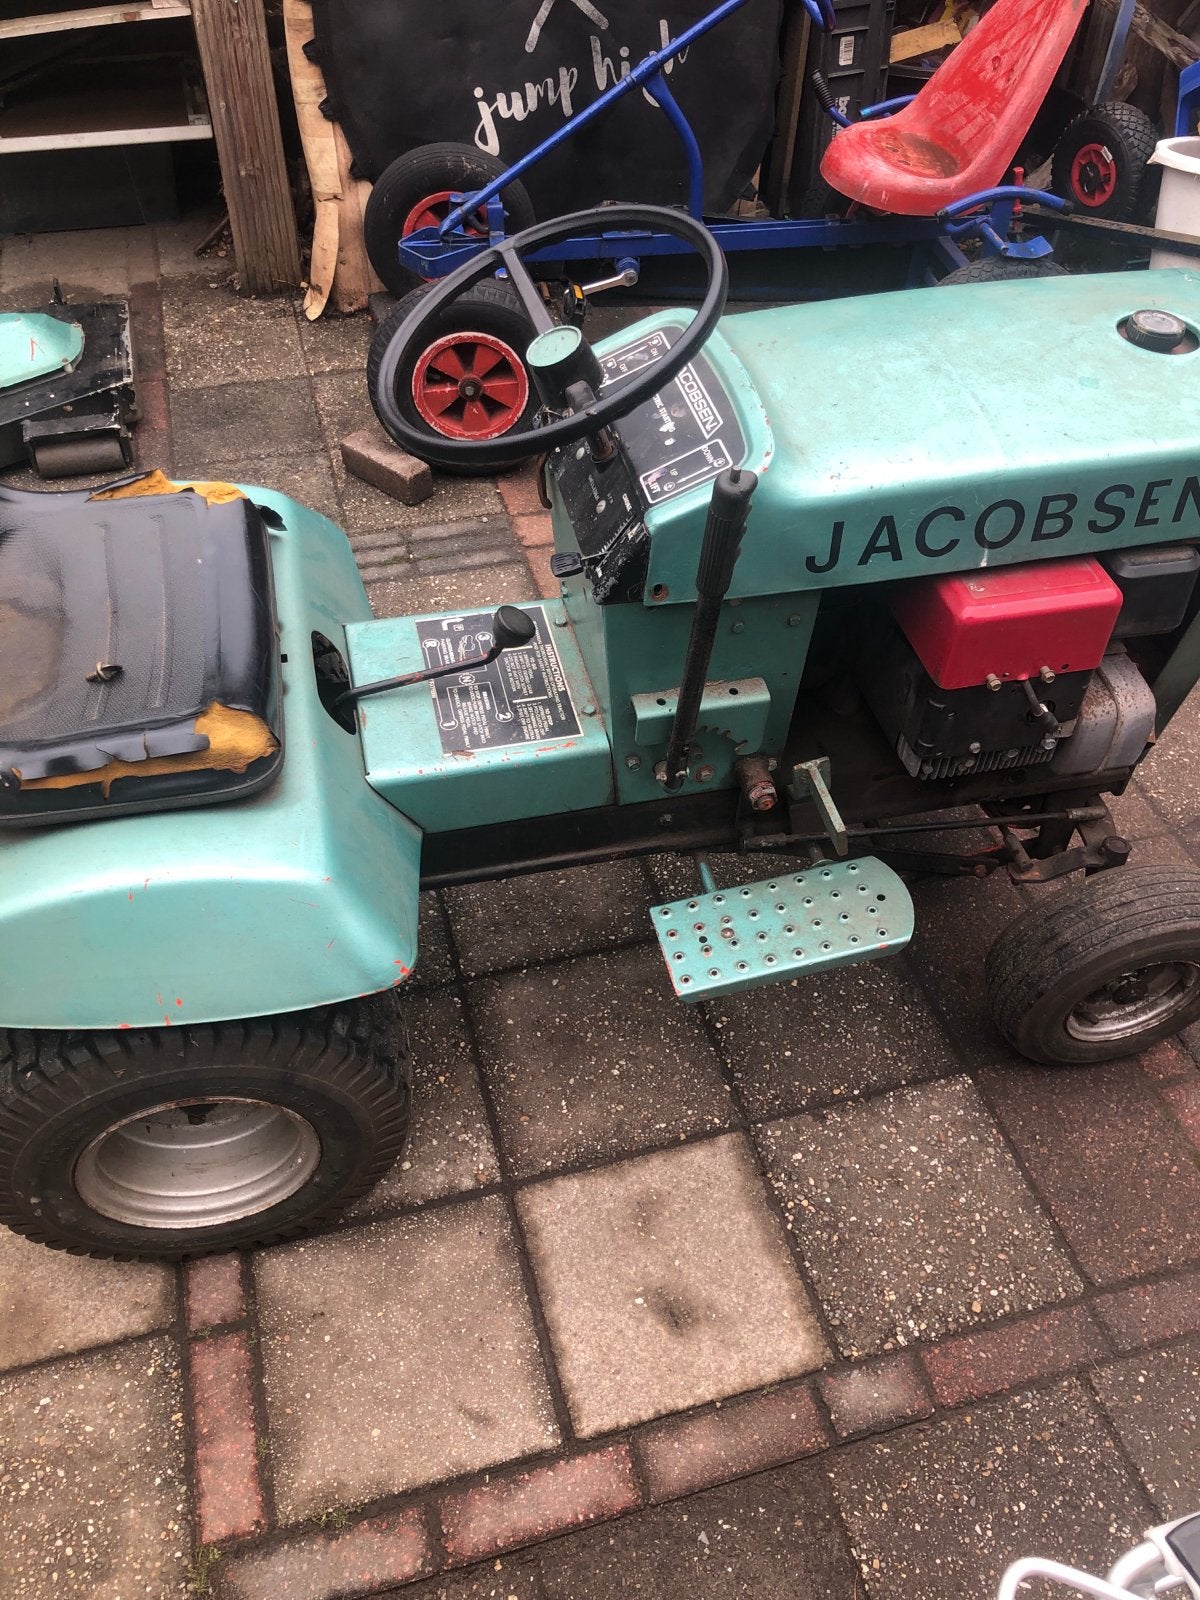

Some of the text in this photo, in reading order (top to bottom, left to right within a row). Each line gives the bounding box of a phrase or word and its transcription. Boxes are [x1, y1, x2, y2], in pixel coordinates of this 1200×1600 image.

[474, 67, 578, 156] jump
[620, 363, 628, 373] OFF
[701, 445, 714, 464] DOWN
[423, 640, 436, 648] R
[544, 644, 565, 691] INSTRUCTIONS
